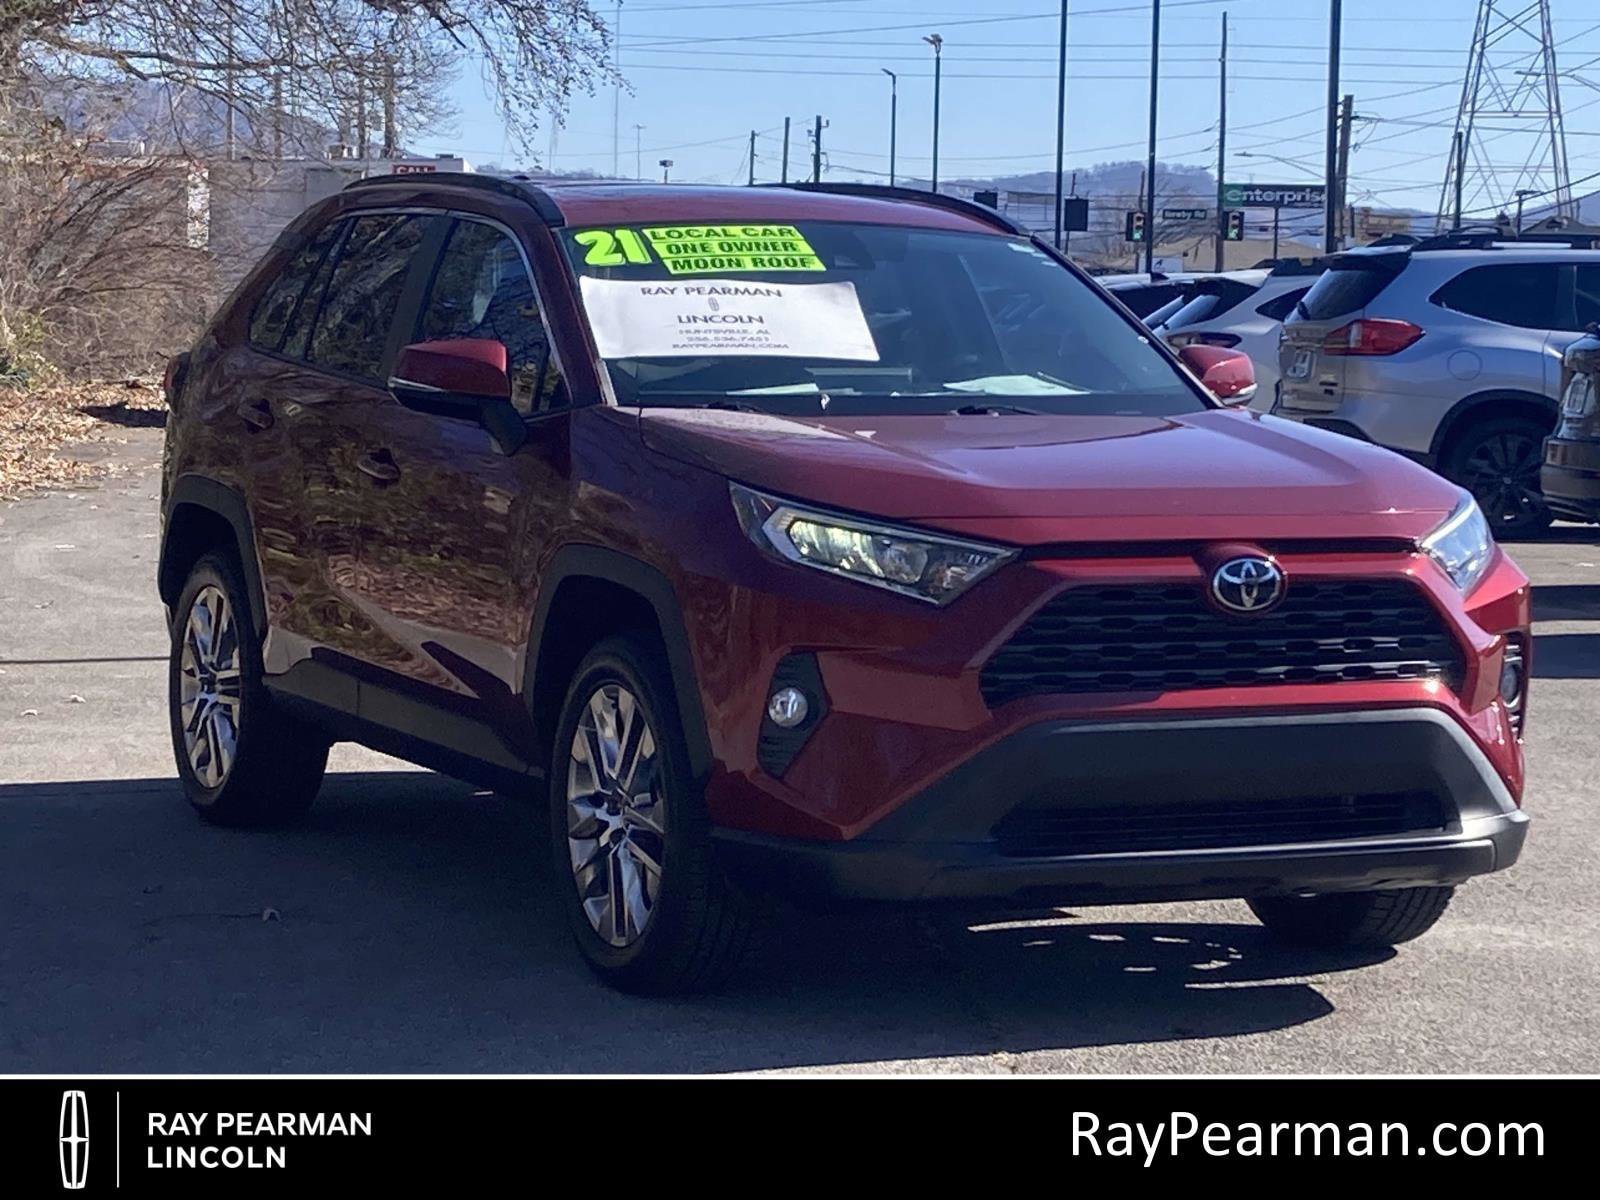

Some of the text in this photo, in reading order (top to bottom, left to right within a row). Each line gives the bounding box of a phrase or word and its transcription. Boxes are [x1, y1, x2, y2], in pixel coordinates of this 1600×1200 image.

[650, 227, 795, 241] LOCAL CAR
[574, 229, 652, 266] 21
[665, 241, 799, 256] ONE OWNER
[672, 256, 815, 271] MOON ROOF
[641, 286, 782, 298] RAY PEARMAN
[677, 314, 765, 325] LINCOLN
